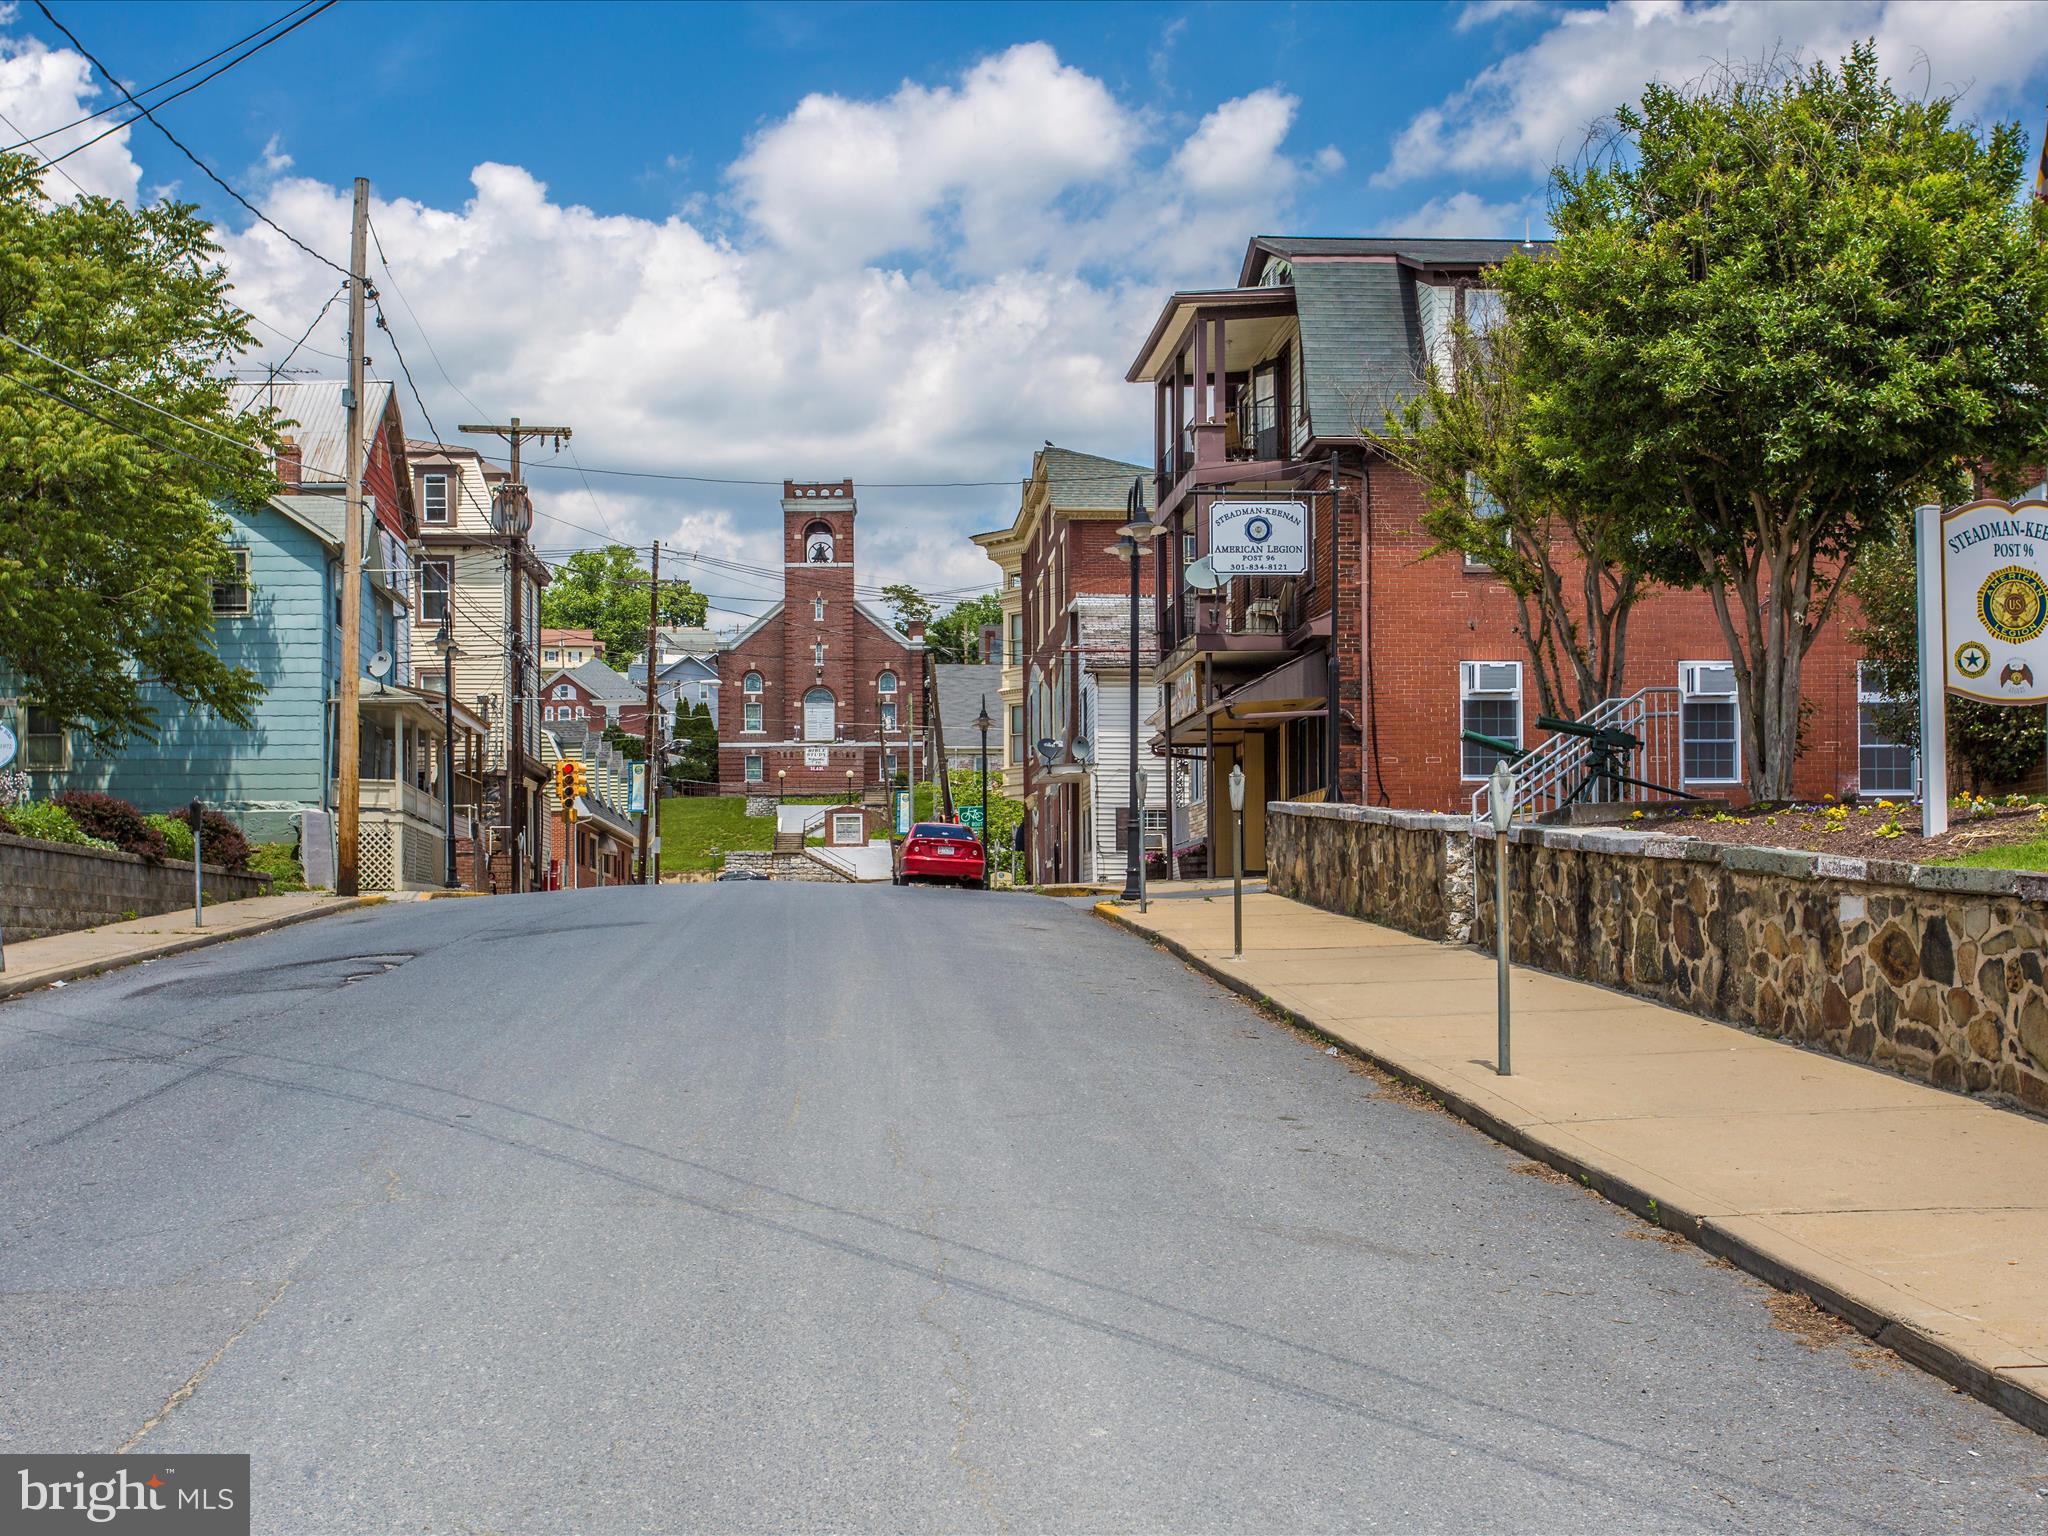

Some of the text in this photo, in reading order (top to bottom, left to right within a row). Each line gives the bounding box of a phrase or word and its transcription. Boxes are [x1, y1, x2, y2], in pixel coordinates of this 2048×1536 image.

[1215, 507, 1302, 527] STEADMAN-KEENAN
[1214, 545, 1304, 554] AMERICAN LEGION
[1993, 543, 2034, 557] POST 96
[1230, 563, 1288, 571] 301-834-8121
[1986, 573, 2044, 597] AMERICAN
[2009, 599, 2021, 610] US
[1994, 623, 2037, 638] LEGION
